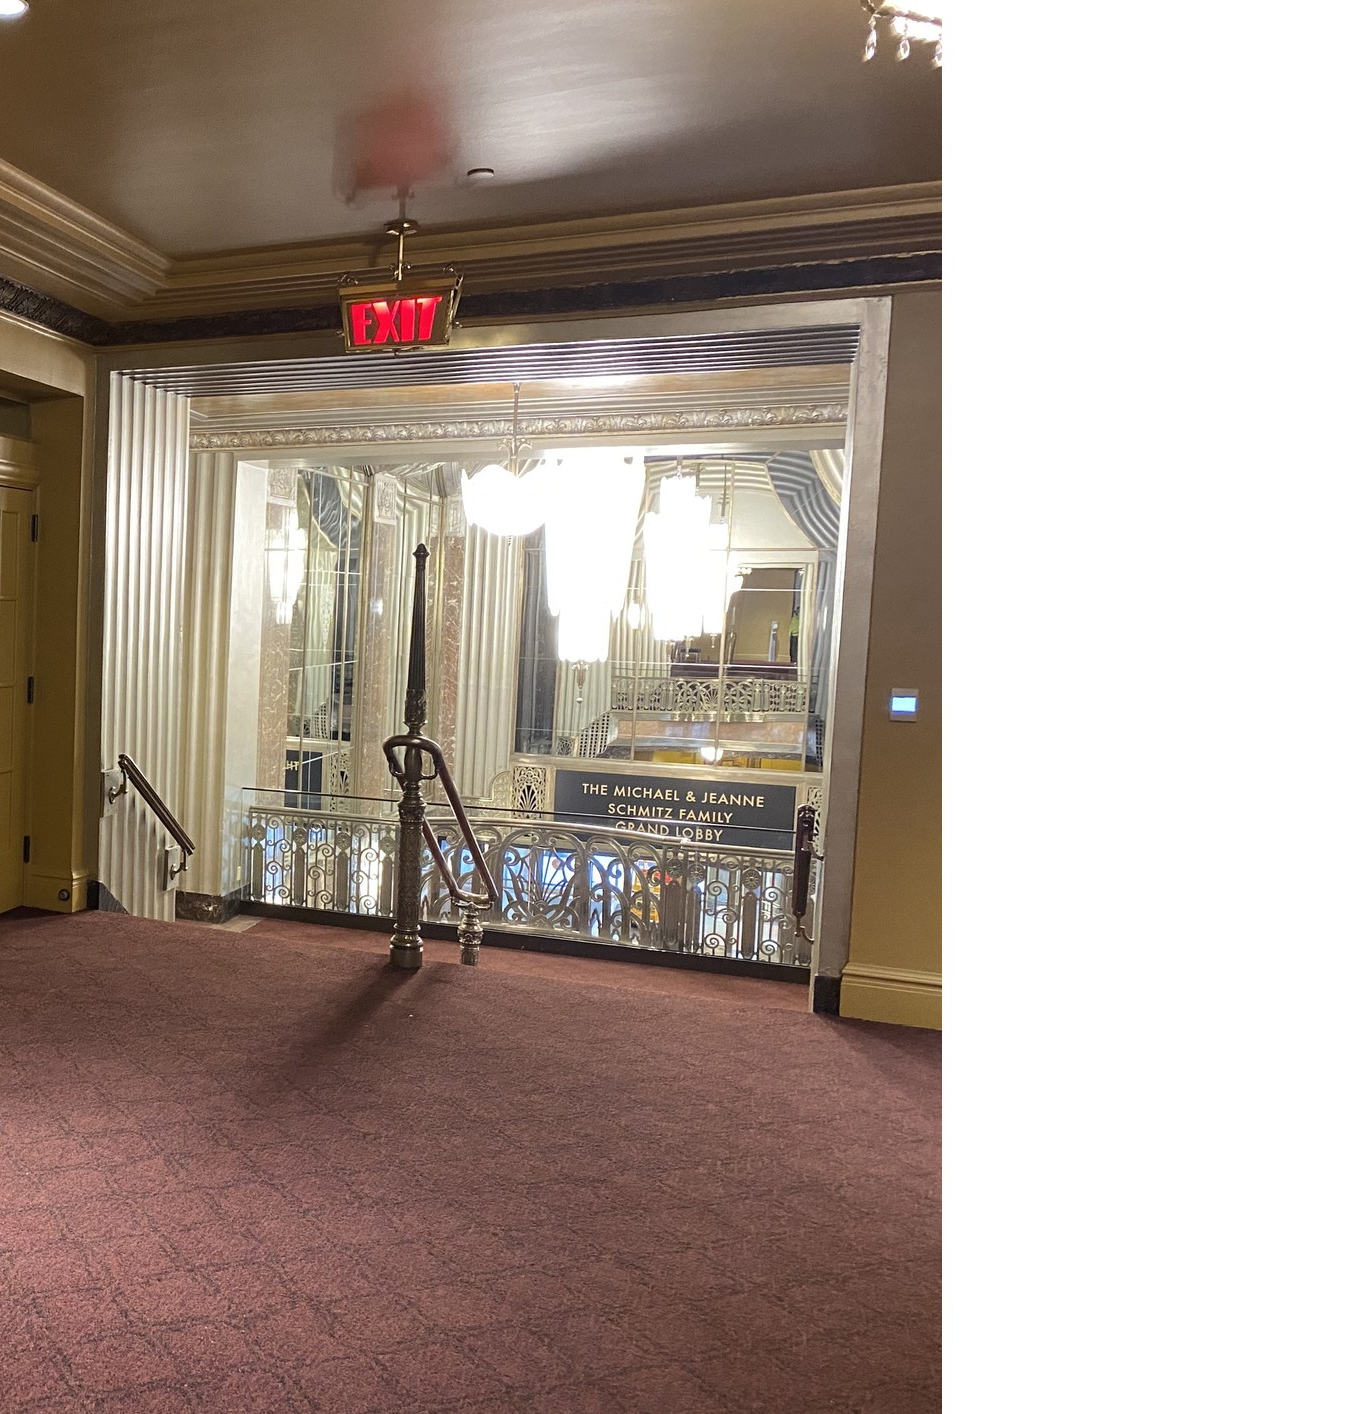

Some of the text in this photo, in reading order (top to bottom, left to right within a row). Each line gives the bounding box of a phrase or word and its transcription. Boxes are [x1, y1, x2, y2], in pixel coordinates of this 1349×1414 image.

[351, 297, 442, 345] EXIT
[582, 783, 765, 808] THE MICHAEL & JEANNE
[608, 803, 733, 824] SCHMITZ FAMILY
[615, 821, 723, 842] GRAND LOBBY
